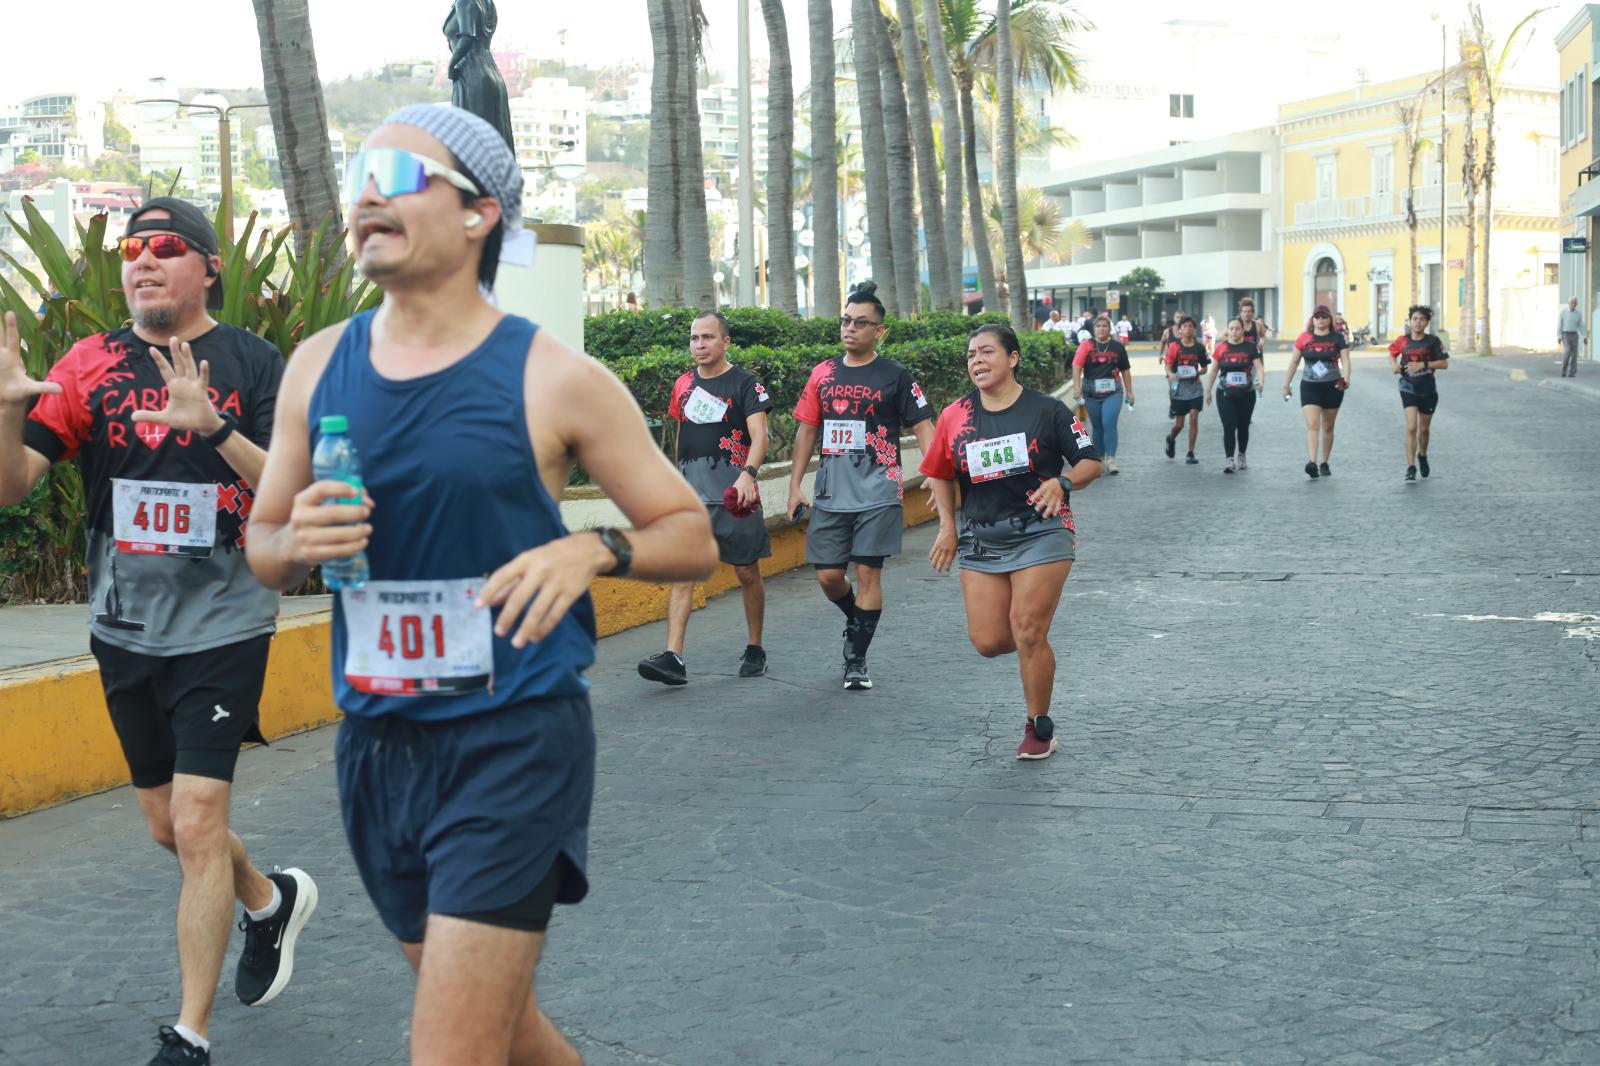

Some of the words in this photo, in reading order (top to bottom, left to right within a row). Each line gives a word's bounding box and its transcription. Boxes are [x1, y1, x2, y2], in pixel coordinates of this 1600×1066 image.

[102, 385, 242, 417] CARRA
[820, 385, 882, 402] CARRERA
[831, 430, 852, 444] 312
[981, 446, 1014, 468] 348
[133, 502, 190, 534] 406
[378, 614, 445, 660] 401
